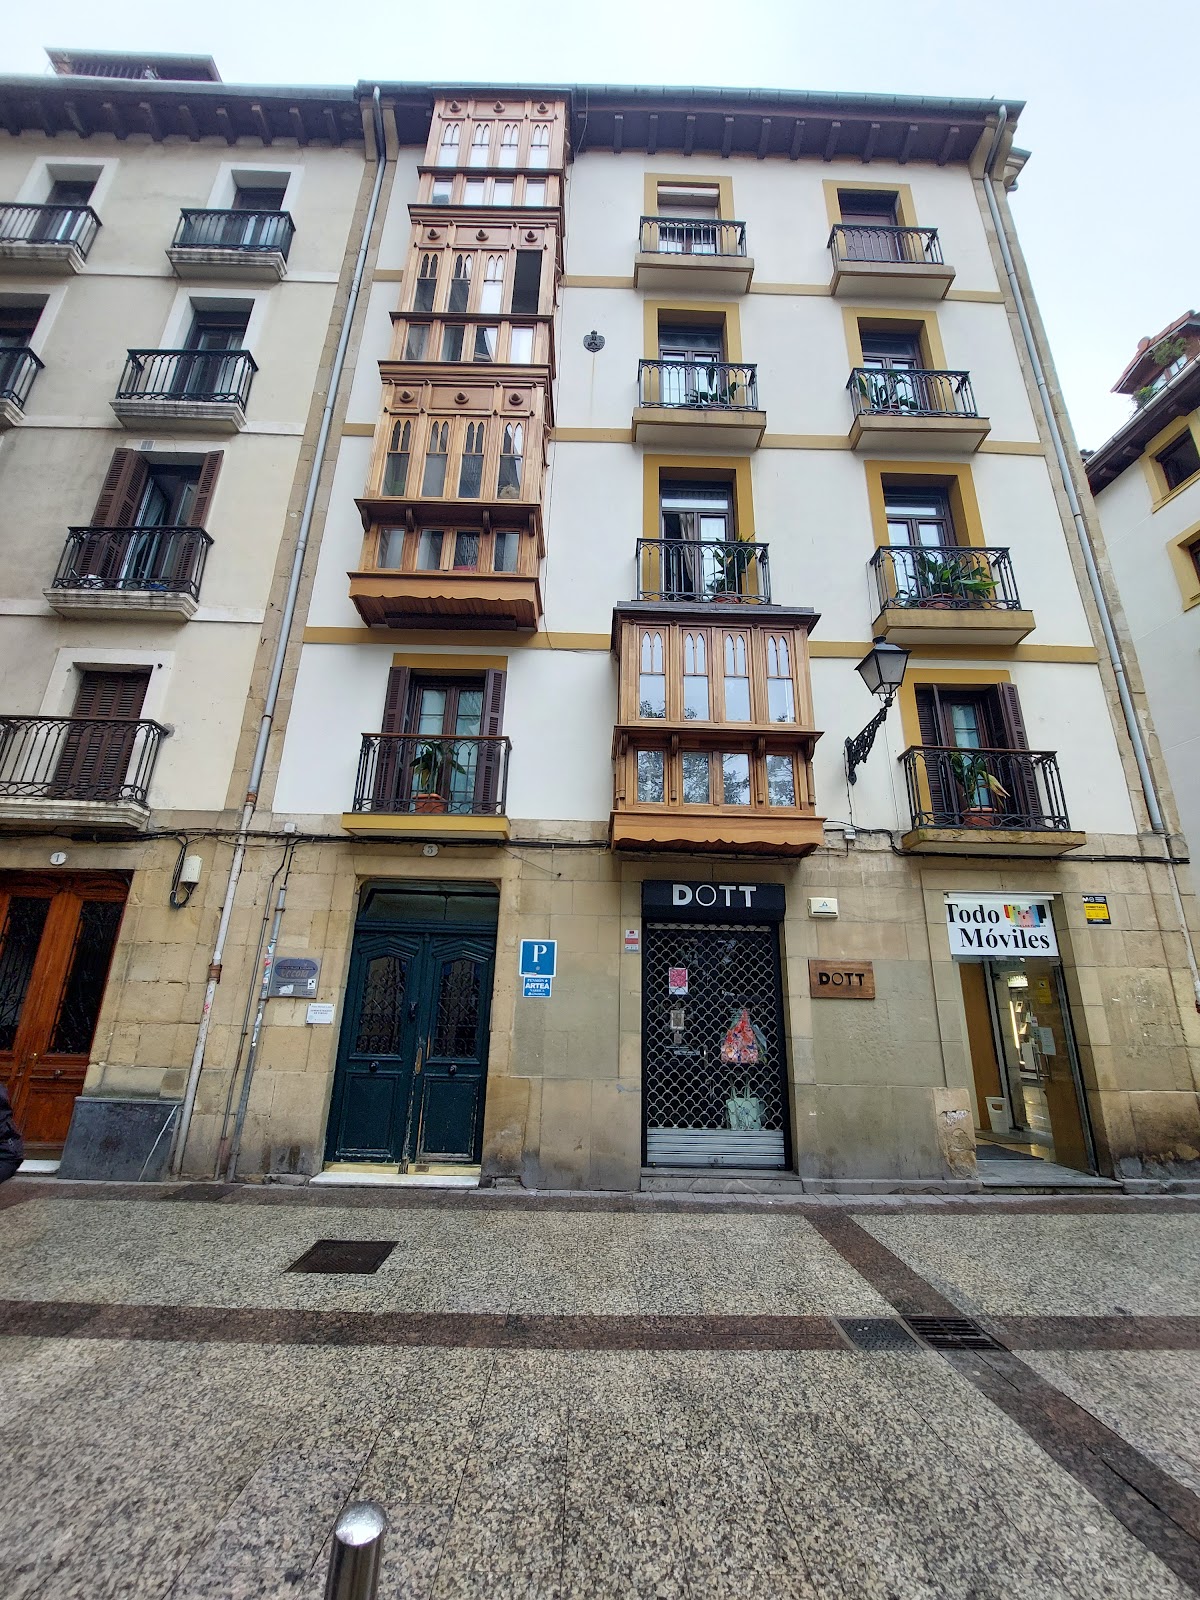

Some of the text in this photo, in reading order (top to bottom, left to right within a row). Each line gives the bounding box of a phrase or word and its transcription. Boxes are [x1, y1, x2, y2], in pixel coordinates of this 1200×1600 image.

[672, 884, 757, 908] DOTT
[944, 904, 1000, 924] Todo
[958, 928, 1050, 949] Móviles
[532, 944, 548, 963] P
[818, 972, 865, 987] DOTT
